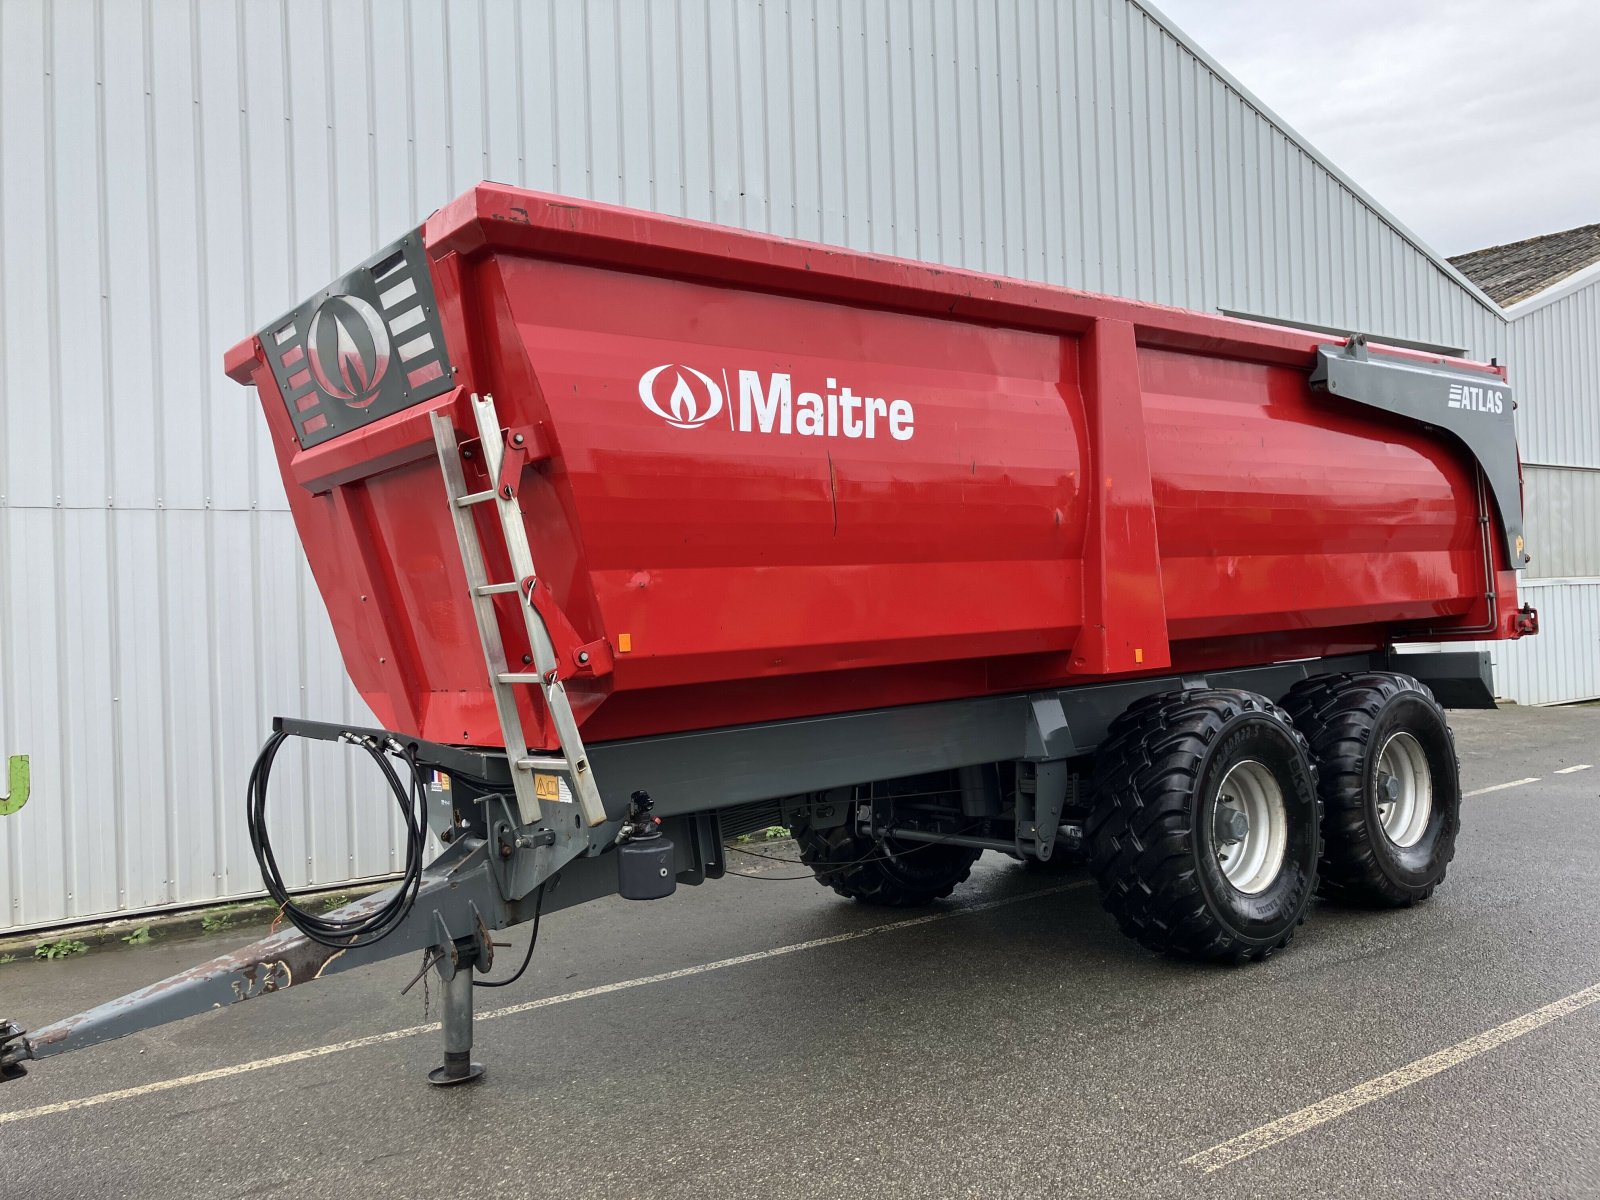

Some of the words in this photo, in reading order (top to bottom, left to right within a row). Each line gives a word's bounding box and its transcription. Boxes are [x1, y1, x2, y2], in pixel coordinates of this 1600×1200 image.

[739, 369, 914, 441] Maitre
[1461, 385, 1503, 414] ATLAS
[1288, 756, 1312, 804] BKT
